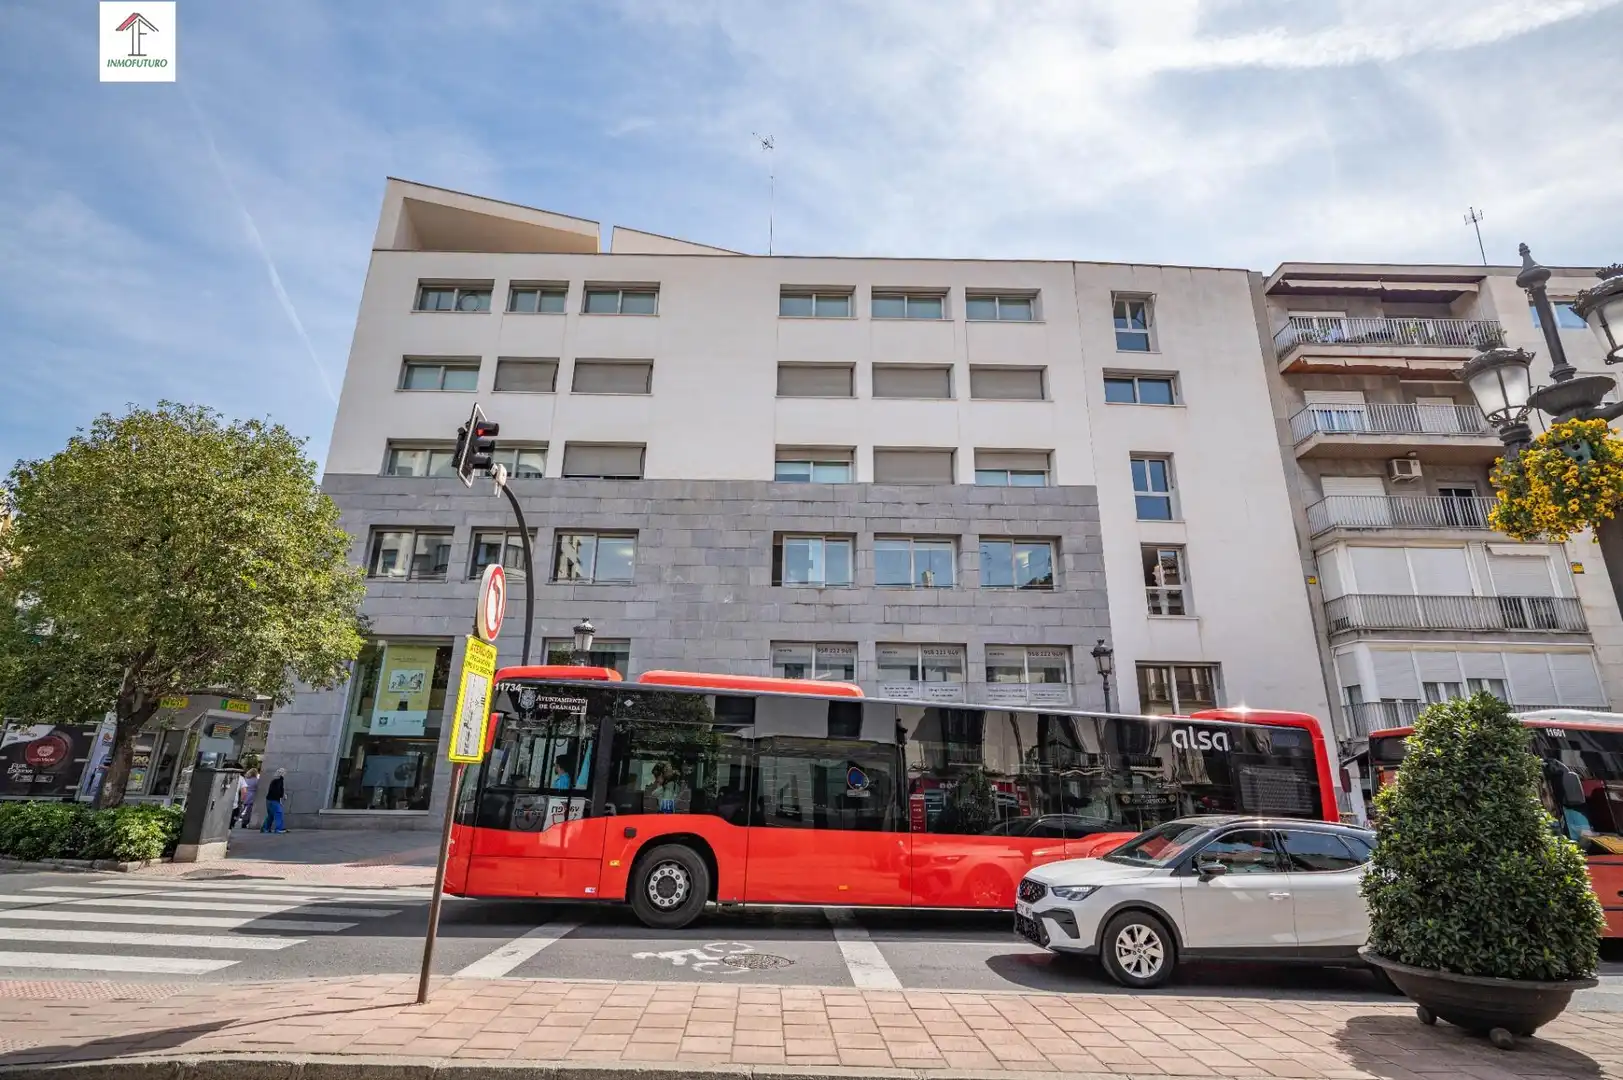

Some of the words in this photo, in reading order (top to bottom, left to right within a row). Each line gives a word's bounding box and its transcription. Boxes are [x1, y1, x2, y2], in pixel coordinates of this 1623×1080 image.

[495, 683, 522, 692] 11734
[536, 694, 586, 704] AYUNTAMIENTO
[228, 702, 249, 712] ONCE
[549, 702, 581, 711] GRANADA
[1545, 727, 1566, 738] 11601
[1171, 726, 1230, 752] alsa
